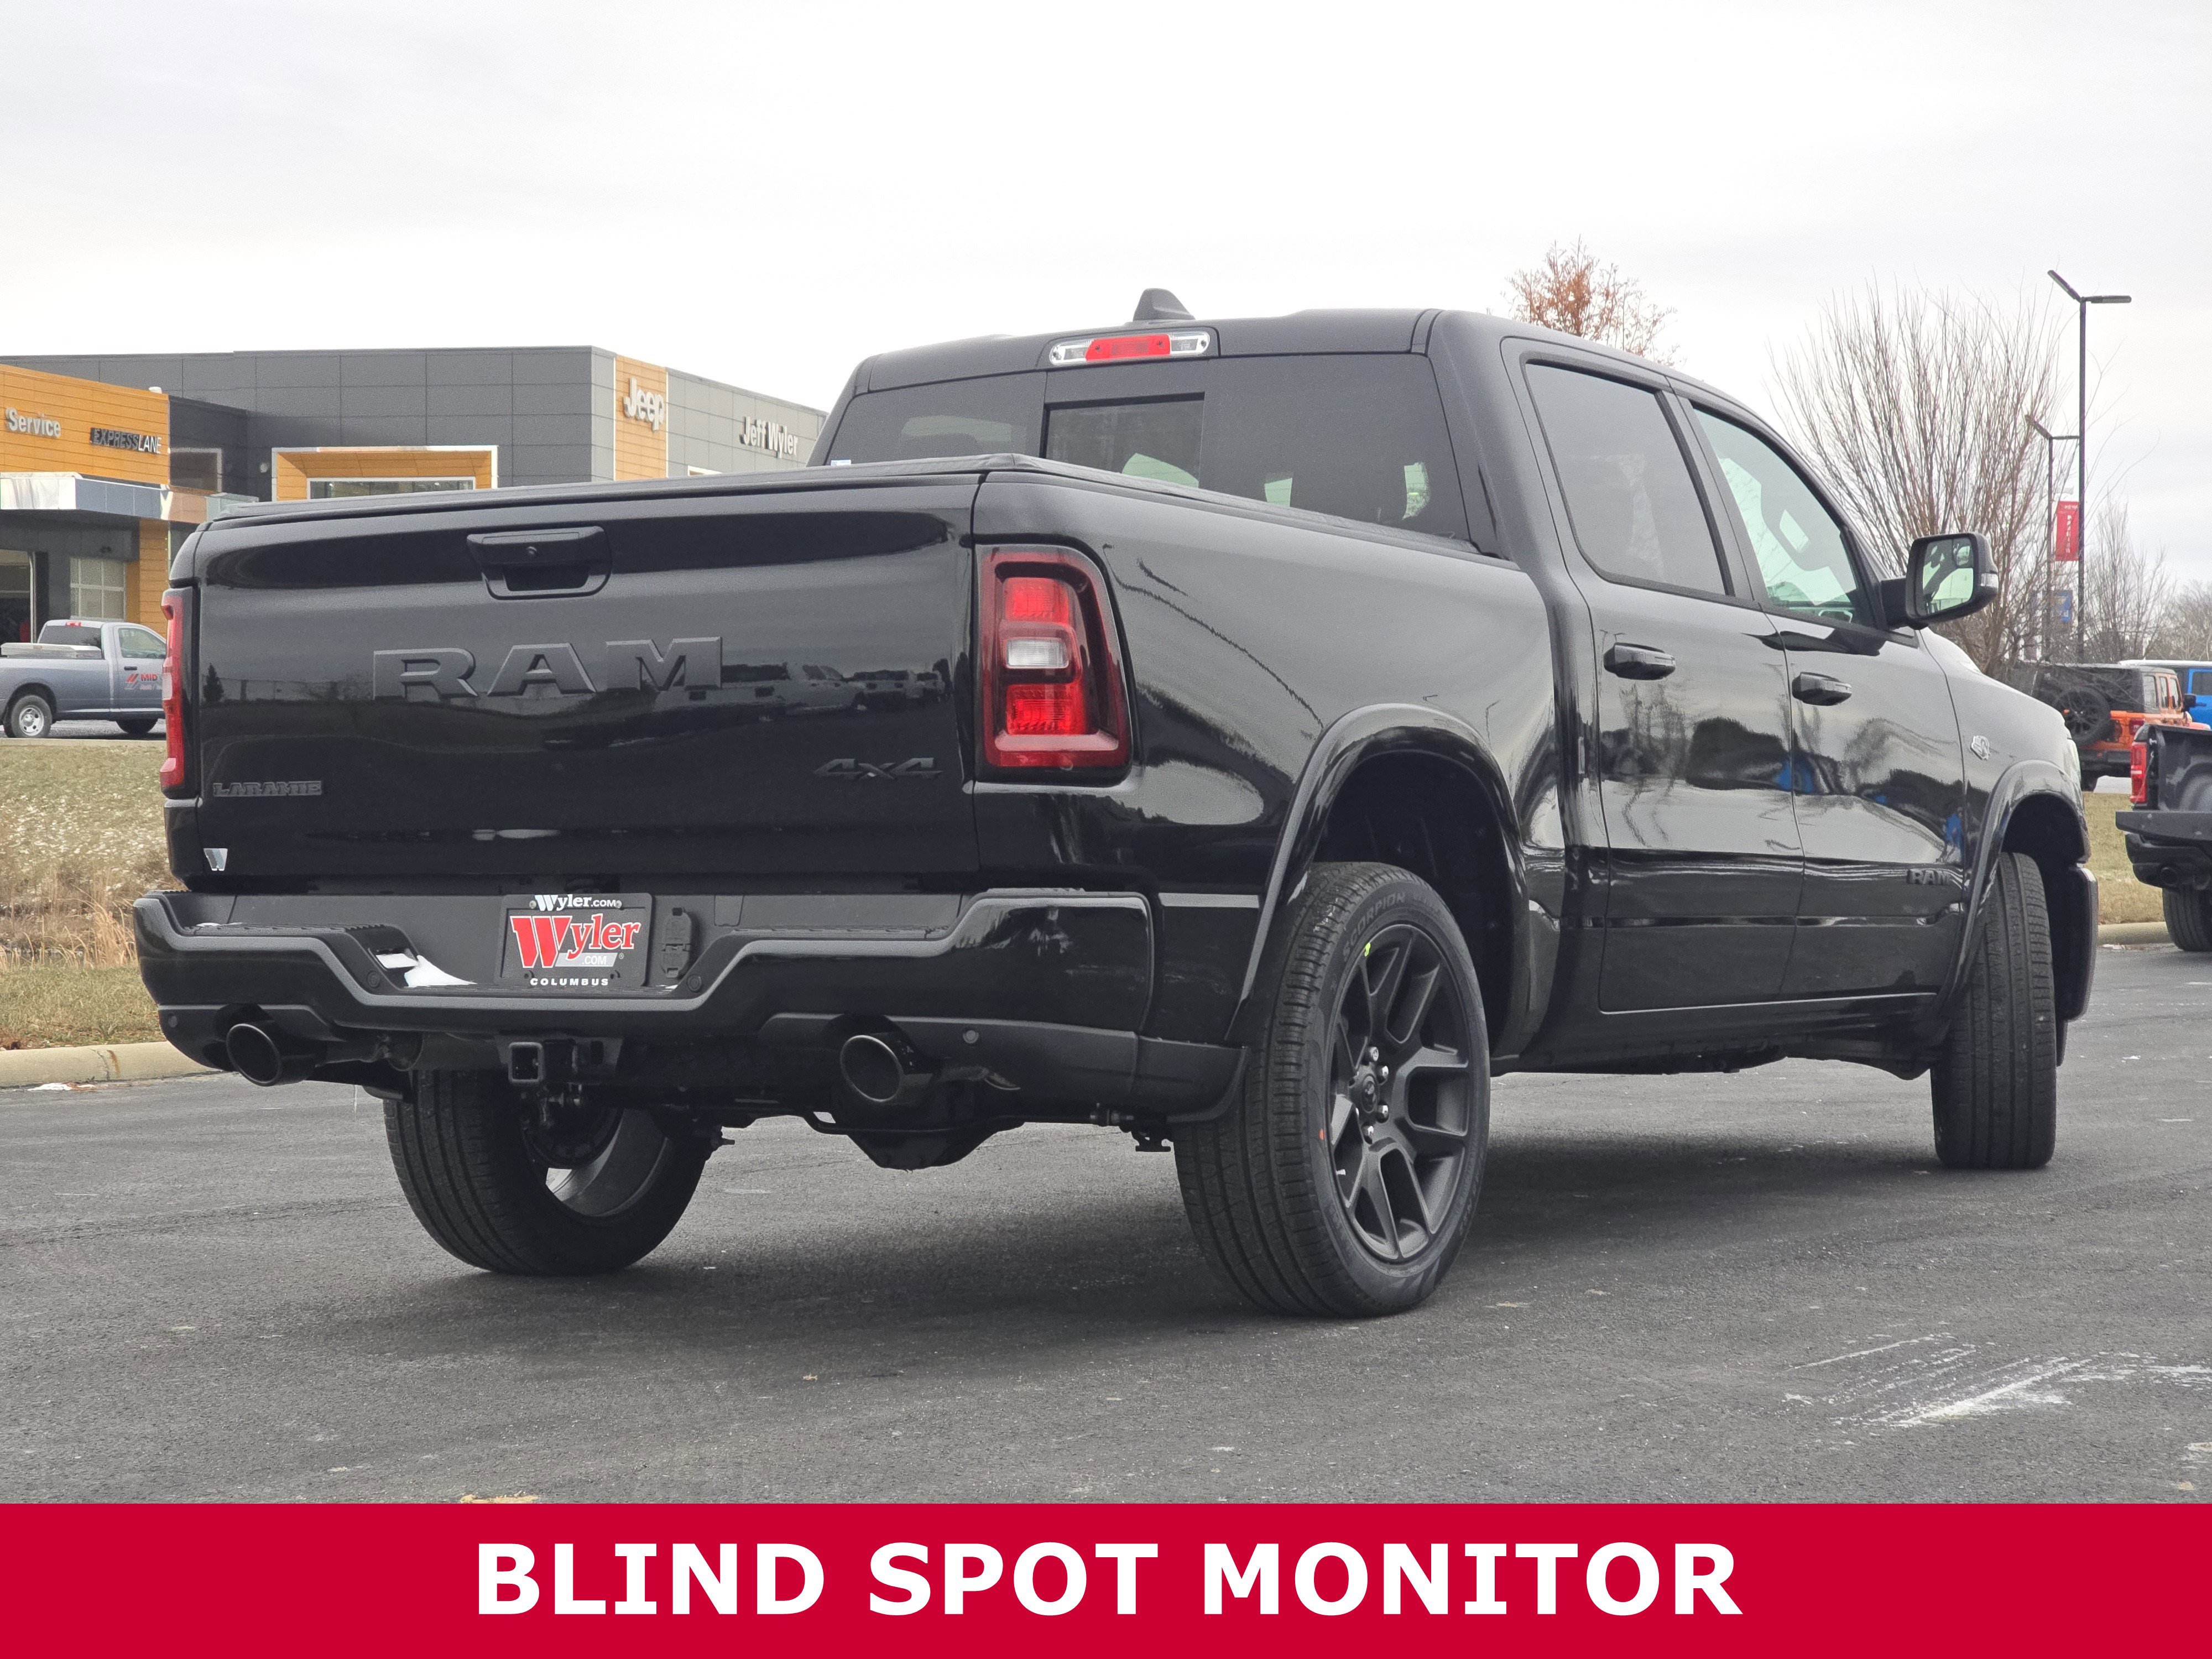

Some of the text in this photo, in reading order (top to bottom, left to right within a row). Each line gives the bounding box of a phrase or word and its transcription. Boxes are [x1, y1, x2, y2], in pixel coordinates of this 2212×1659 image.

[6, 407, 61, 437] Service
[623, 377, 664, 432] Jeep
[740, 416, 799, 458] Jeff Wyler
[373, 637, 722, 701] RAM
[213, 780, 322, 797] LARAMIE
[1907, 868, 1949, 885] RAM
[509, 913, 641, 968] Wyler
[1343, 891, 1407, 962] SCORPION
